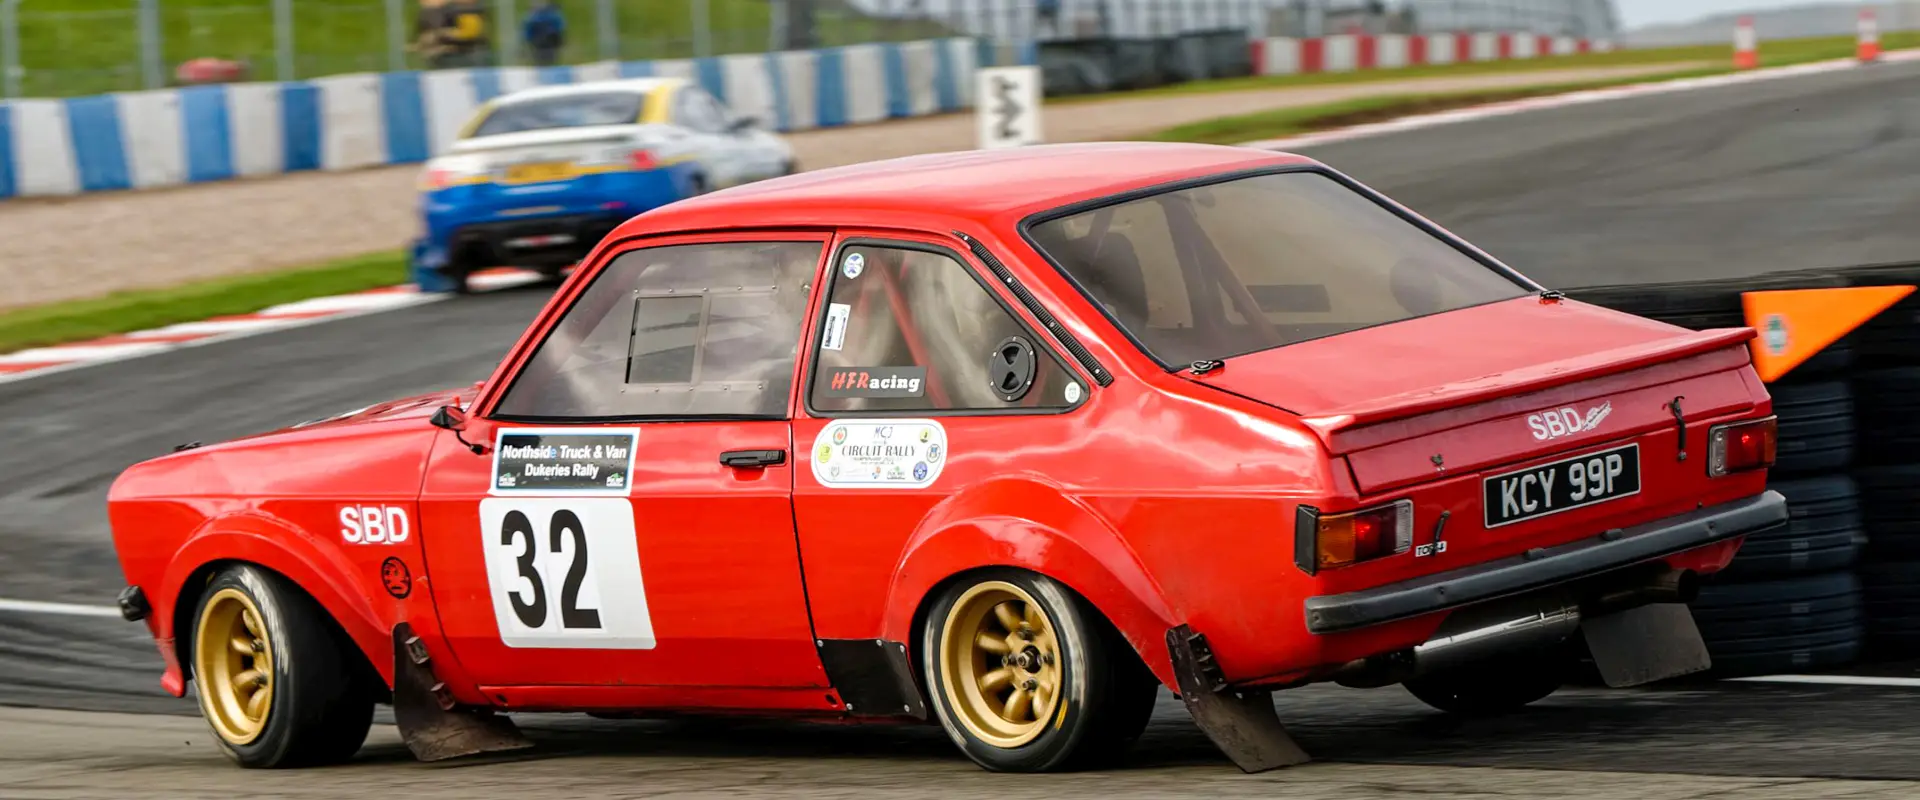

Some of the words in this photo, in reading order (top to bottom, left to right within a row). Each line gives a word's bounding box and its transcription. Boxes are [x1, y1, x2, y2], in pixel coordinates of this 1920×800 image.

[1528, 407, 1581, 440] SBD
[502, 444, 558, 459] Northside
[559, 444, 592, 459] Truck
[593, 444, 603, 459] &
[605, 444, 627, 459] Van
[841, 445, 883, 457] CIRCUIT
[884, 445, 917, 457] RALLY
[524, 463, 571, 477] Dukeries
[571, 463, 600, 479] Rally
[1501, 468, 1556, 518] KCY
[1568, 453, 1623, 501] 99P
[339, 506, 410, 544] SBD
[500, 508, 603, 629] 32
